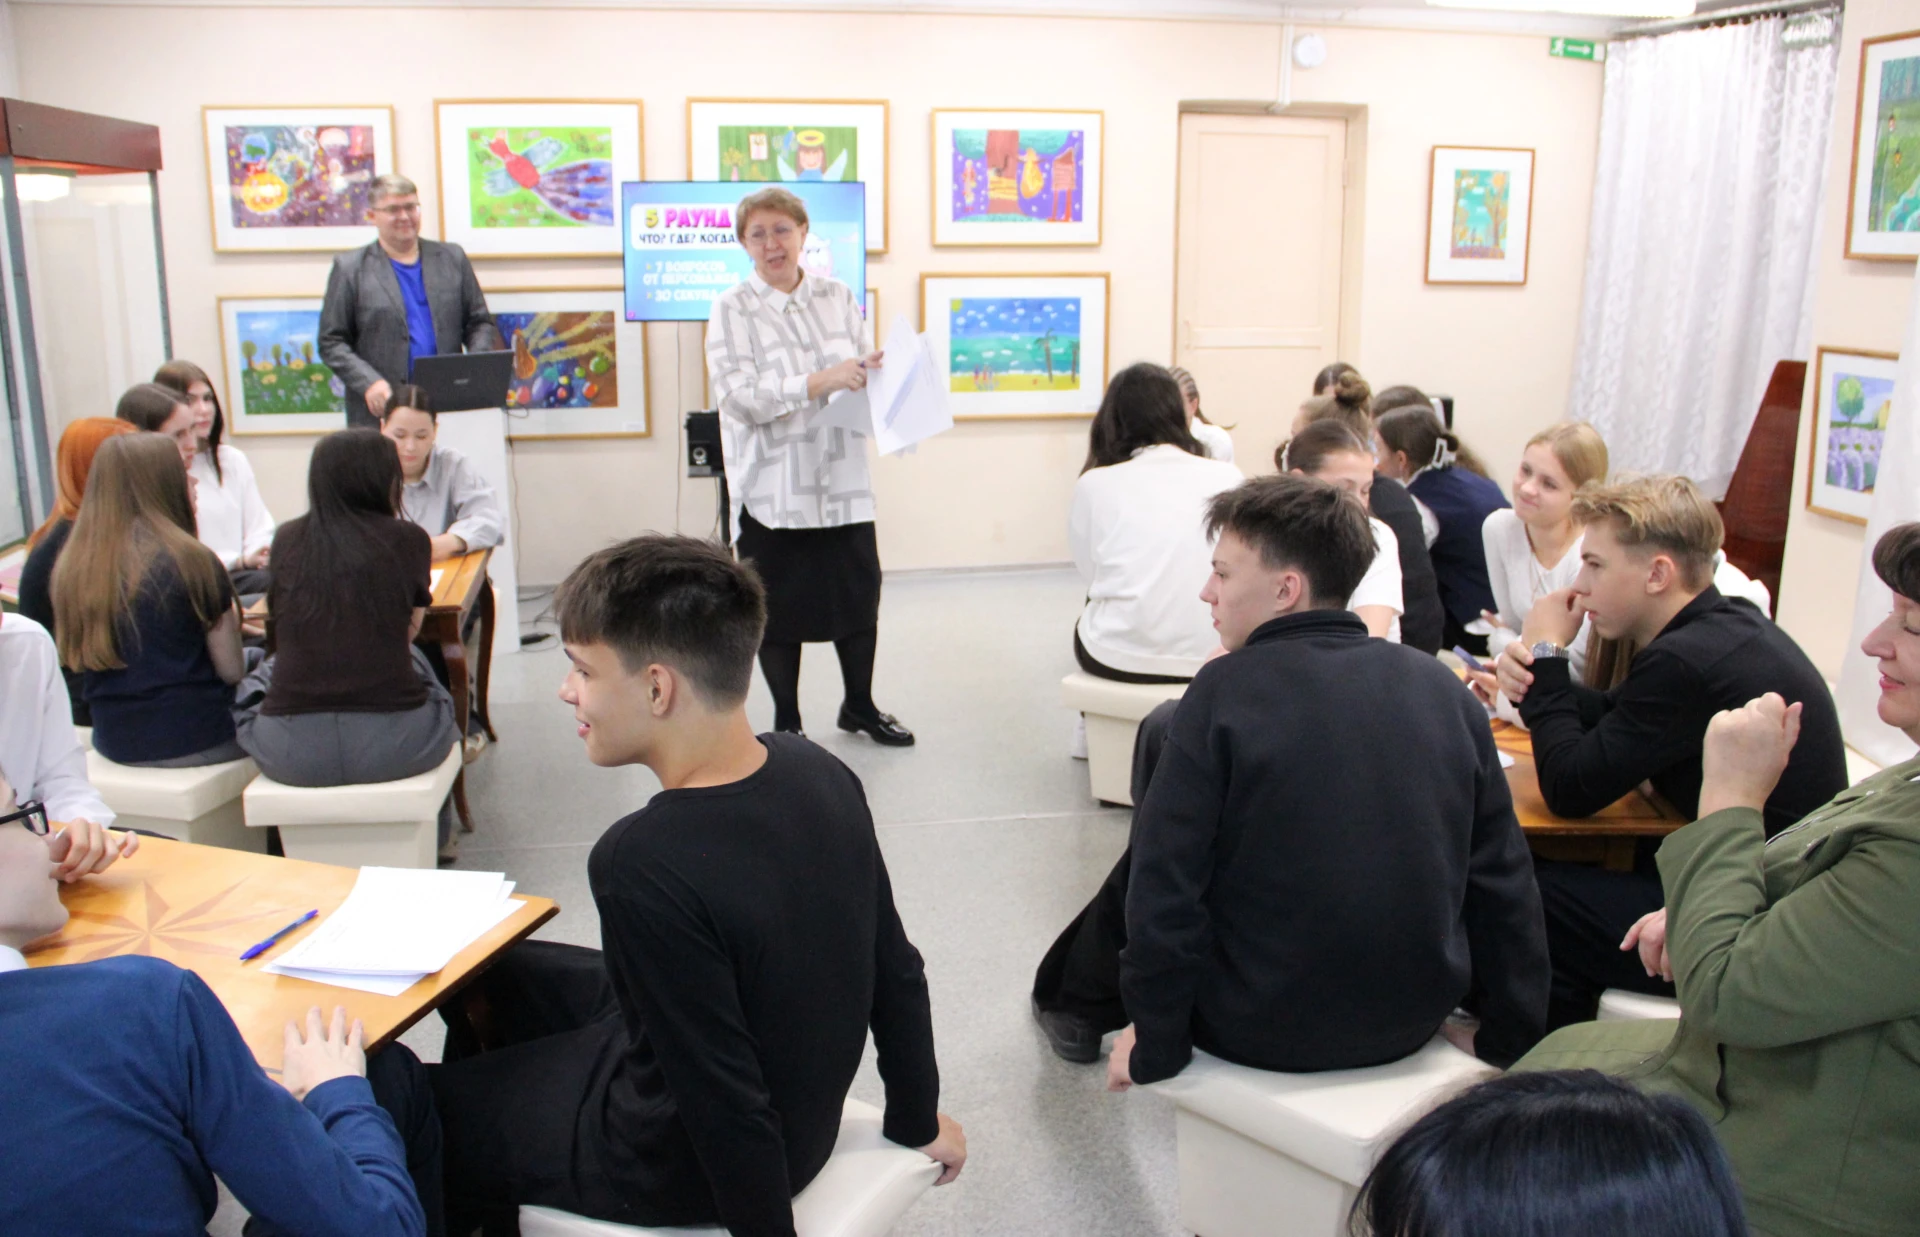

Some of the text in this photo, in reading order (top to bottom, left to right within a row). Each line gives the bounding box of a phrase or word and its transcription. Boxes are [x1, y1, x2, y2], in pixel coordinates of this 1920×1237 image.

[645, 208, 732, 228] 5 РАУНД
[639, 233, 738, 244] ЧТО? ГДЕ? КОГДА
[655, 261, 727, 273] 7 ВОПРОСОВ
[643, 272, 659, 285] ОТ
[655, 289, 672, 302] 30
